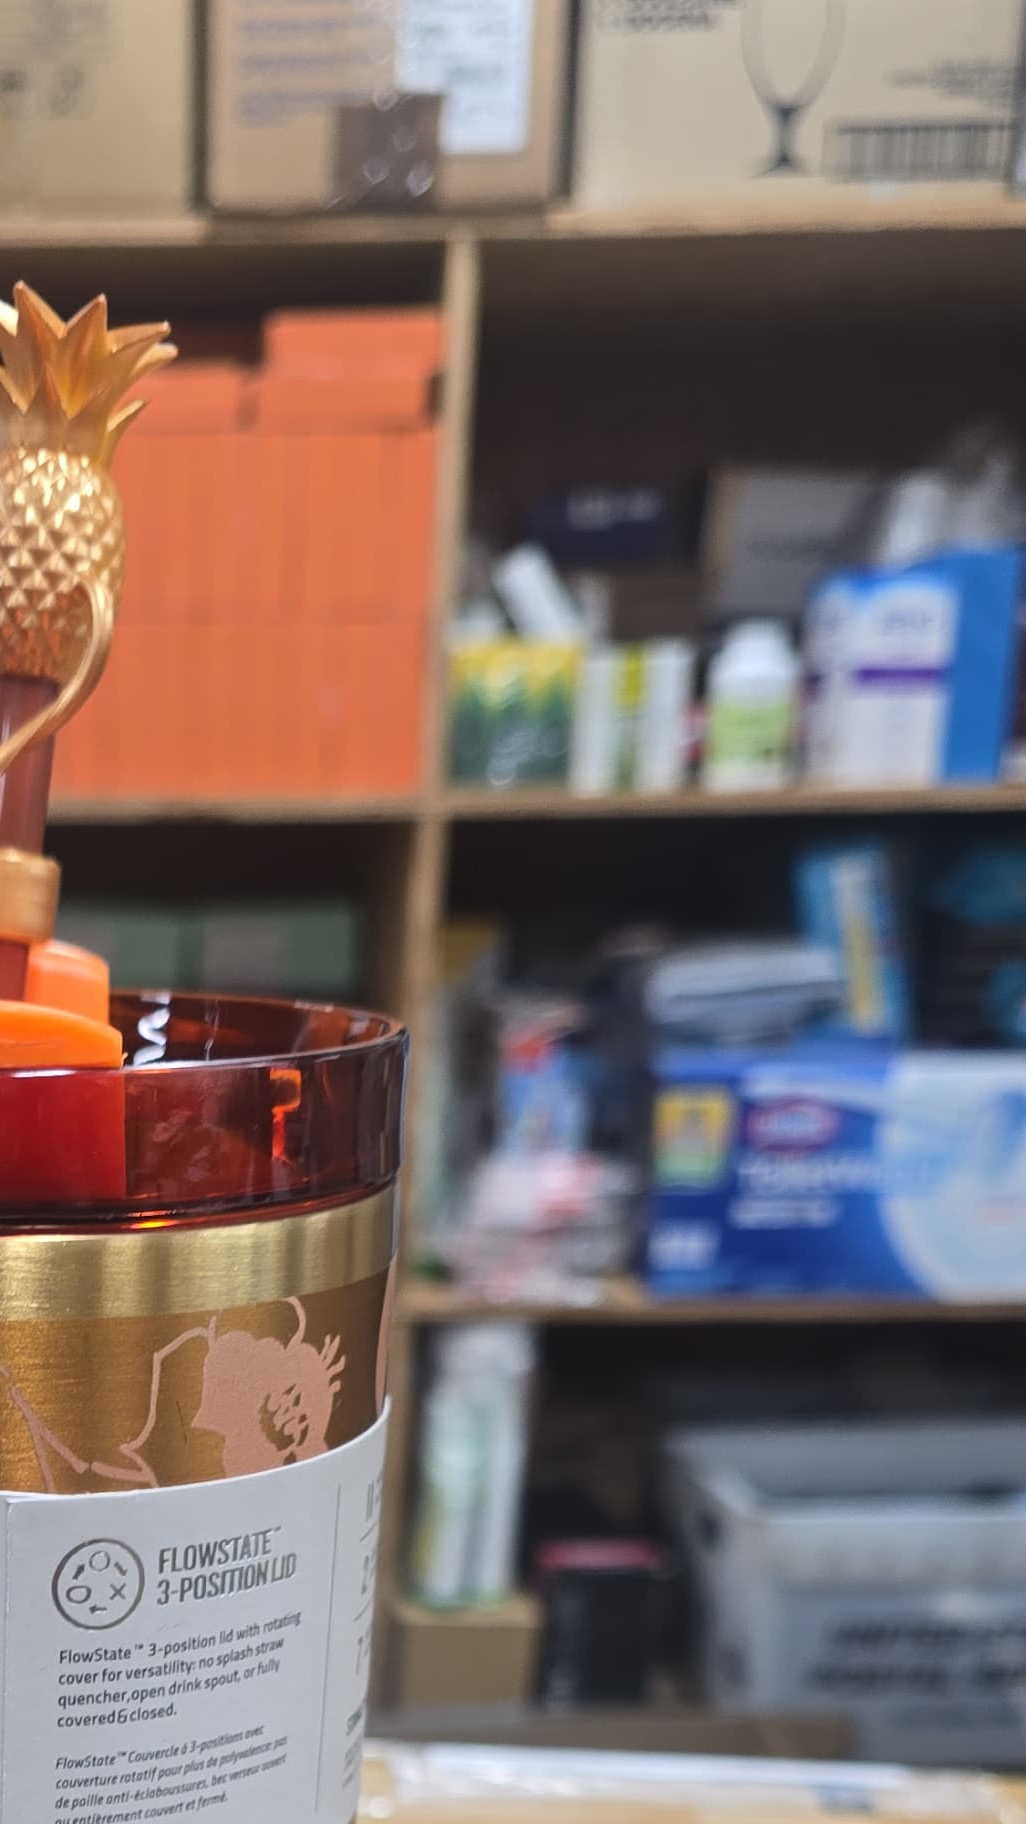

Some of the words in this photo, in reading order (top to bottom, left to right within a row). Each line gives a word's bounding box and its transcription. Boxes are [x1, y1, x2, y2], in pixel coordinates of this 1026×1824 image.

[156, 1559, 269, 1606] 3-POSITION
[271, 1552, 297, 1583] LID
[148, 1635, 216, 1659] 3-position
[219, 1629, 234, 1645] lid
[236, 1623, 260, 1641] with
[263, 1612, 302, 1633] rotating
[58, 1671, 99, 1686] cover
[101, 1667, 123, 1683] for
[125, 1659, 196, 1681] versatility:
[198, 1657, 214, 1670] no
[216, 1645, 253, 1668] splash
[255, 1638, 284, 1656] straw
[169, 1677, 201, 1695] drink
[204, 1669, 241, 1691] spout,
[243, 1667, 256, 1680] or
[257, 1659, 280, 1676] fully
[55, 1775, 117, 1790] couverture
[119, 1766, 157, 1783] rotatif
[157, 1765, 182, 1781] pour
[183, 1759, 205, 1777] plus
[206, 1755, 219, 1769] de
[128, 1745, 180, 1764] Couvercle
[55, 1796, 69, 1809] de
[71, 1793, 104, 1811] paille
[211, 1774, 227, 1787] bec
[144, 1802, 183, 1819] couvert
[185, 1799, 196, 1811] et
